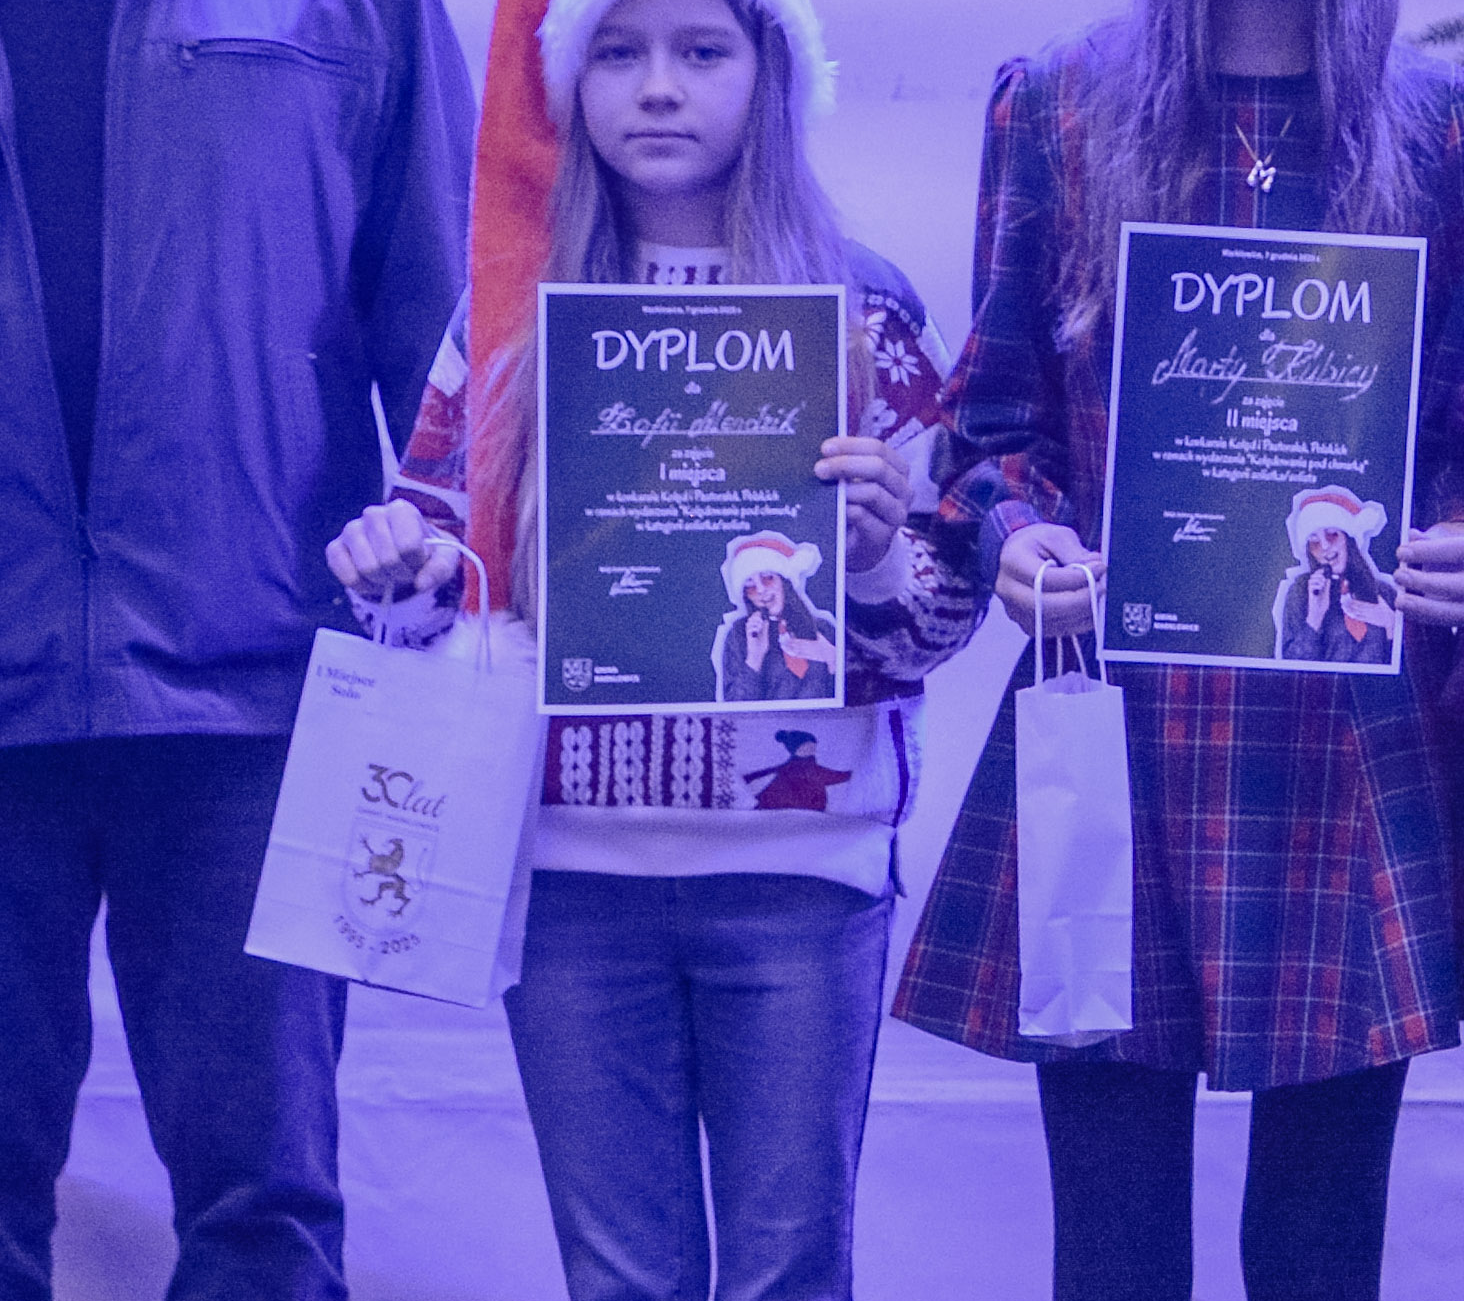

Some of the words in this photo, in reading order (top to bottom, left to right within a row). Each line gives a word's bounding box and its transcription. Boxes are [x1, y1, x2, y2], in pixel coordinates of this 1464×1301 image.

[1171, 272, 1372, 323] DYPLOM
[591, 327, 795, 372] DYPLOM
[1226, 408, 1239, 428] II
[1241, 410, 1299, 437] miejsca
[668, 462, 726, 487] miejsca
[402, 780, 448, 818] lat
